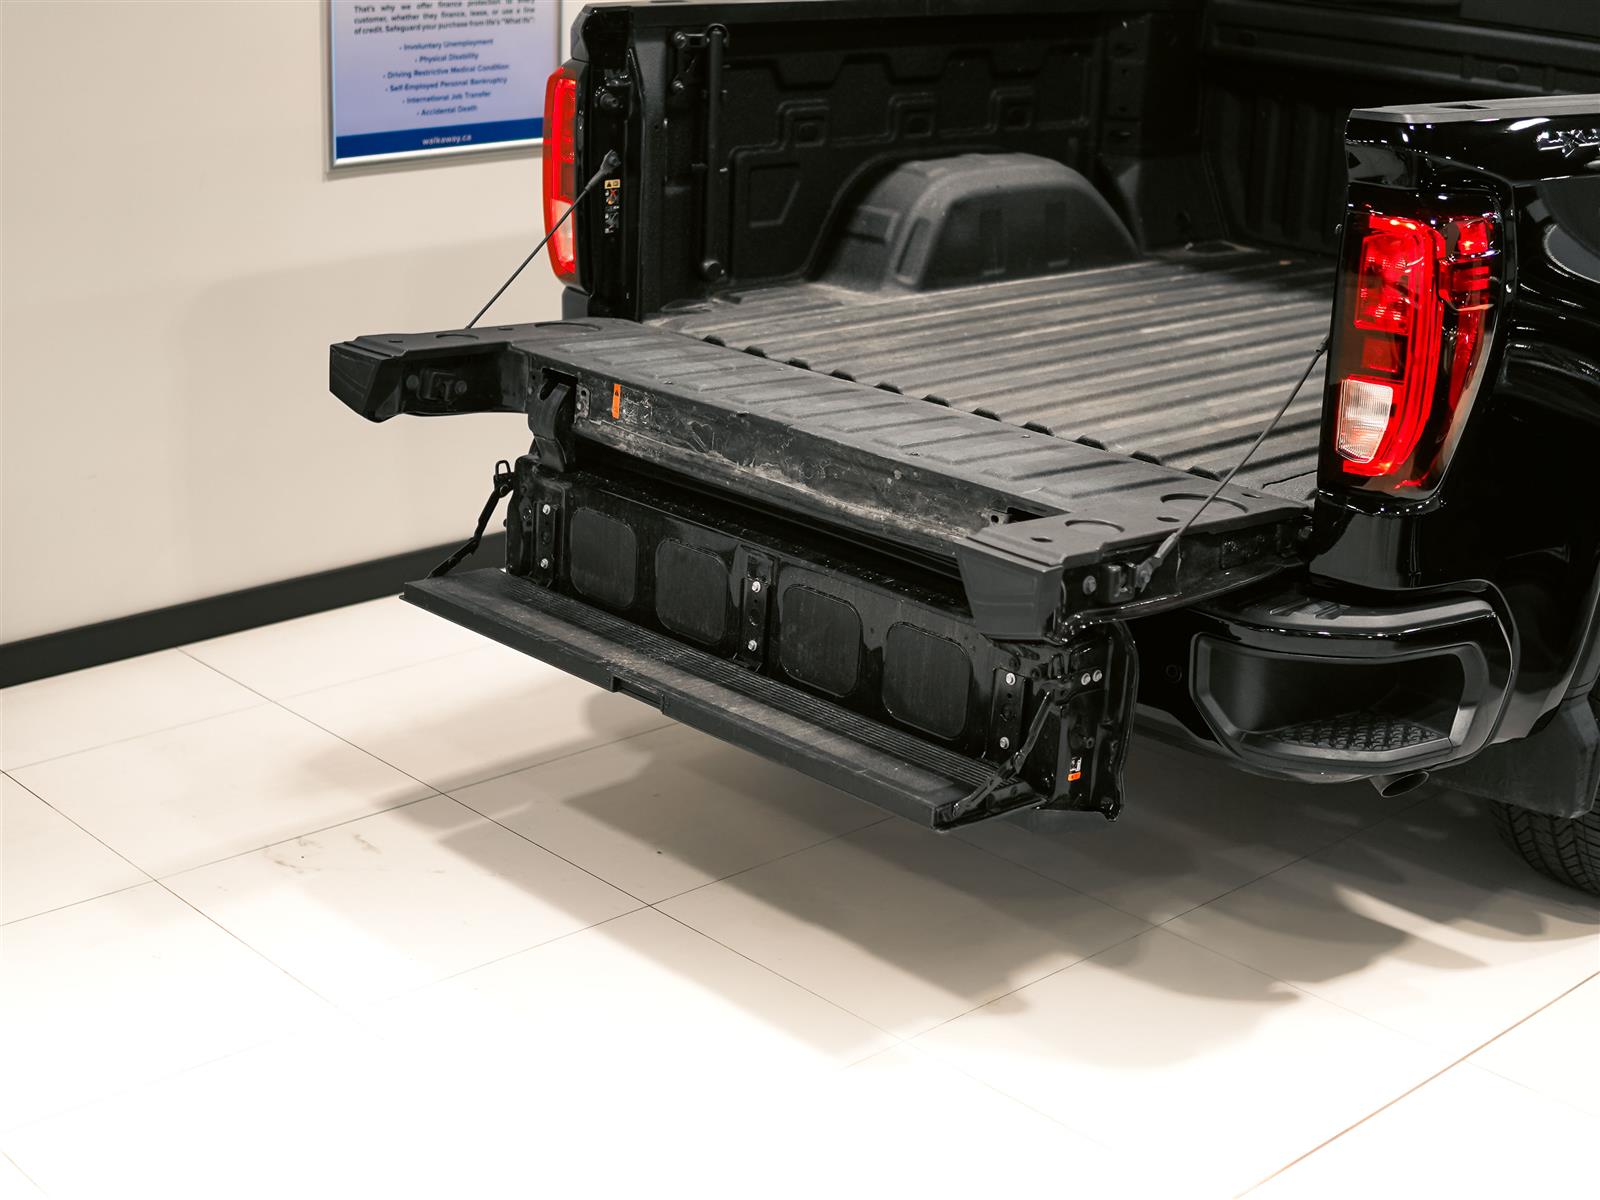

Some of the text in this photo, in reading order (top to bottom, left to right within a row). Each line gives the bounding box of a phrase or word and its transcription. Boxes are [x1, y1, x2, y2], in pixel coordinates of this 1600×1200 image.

[385, 24, 421, 32] Safeguard
[438, 22, 468, 30] purchase
[404, 38, 494, 50] Involuntary Unemployment
[419, 52, 479, 64] Physical Disability
[387, 70, 412, 78] Driving
[414, 68, 448, 76] Restrictive
[477, 64, 509, 72] Condition
[470, 76, 508, 86] Bankruptcy
[406, 94, 450, 103] International
[421, 108, 456, 116] Accidental
[422, 134, 472, 146] walkaway.ca
